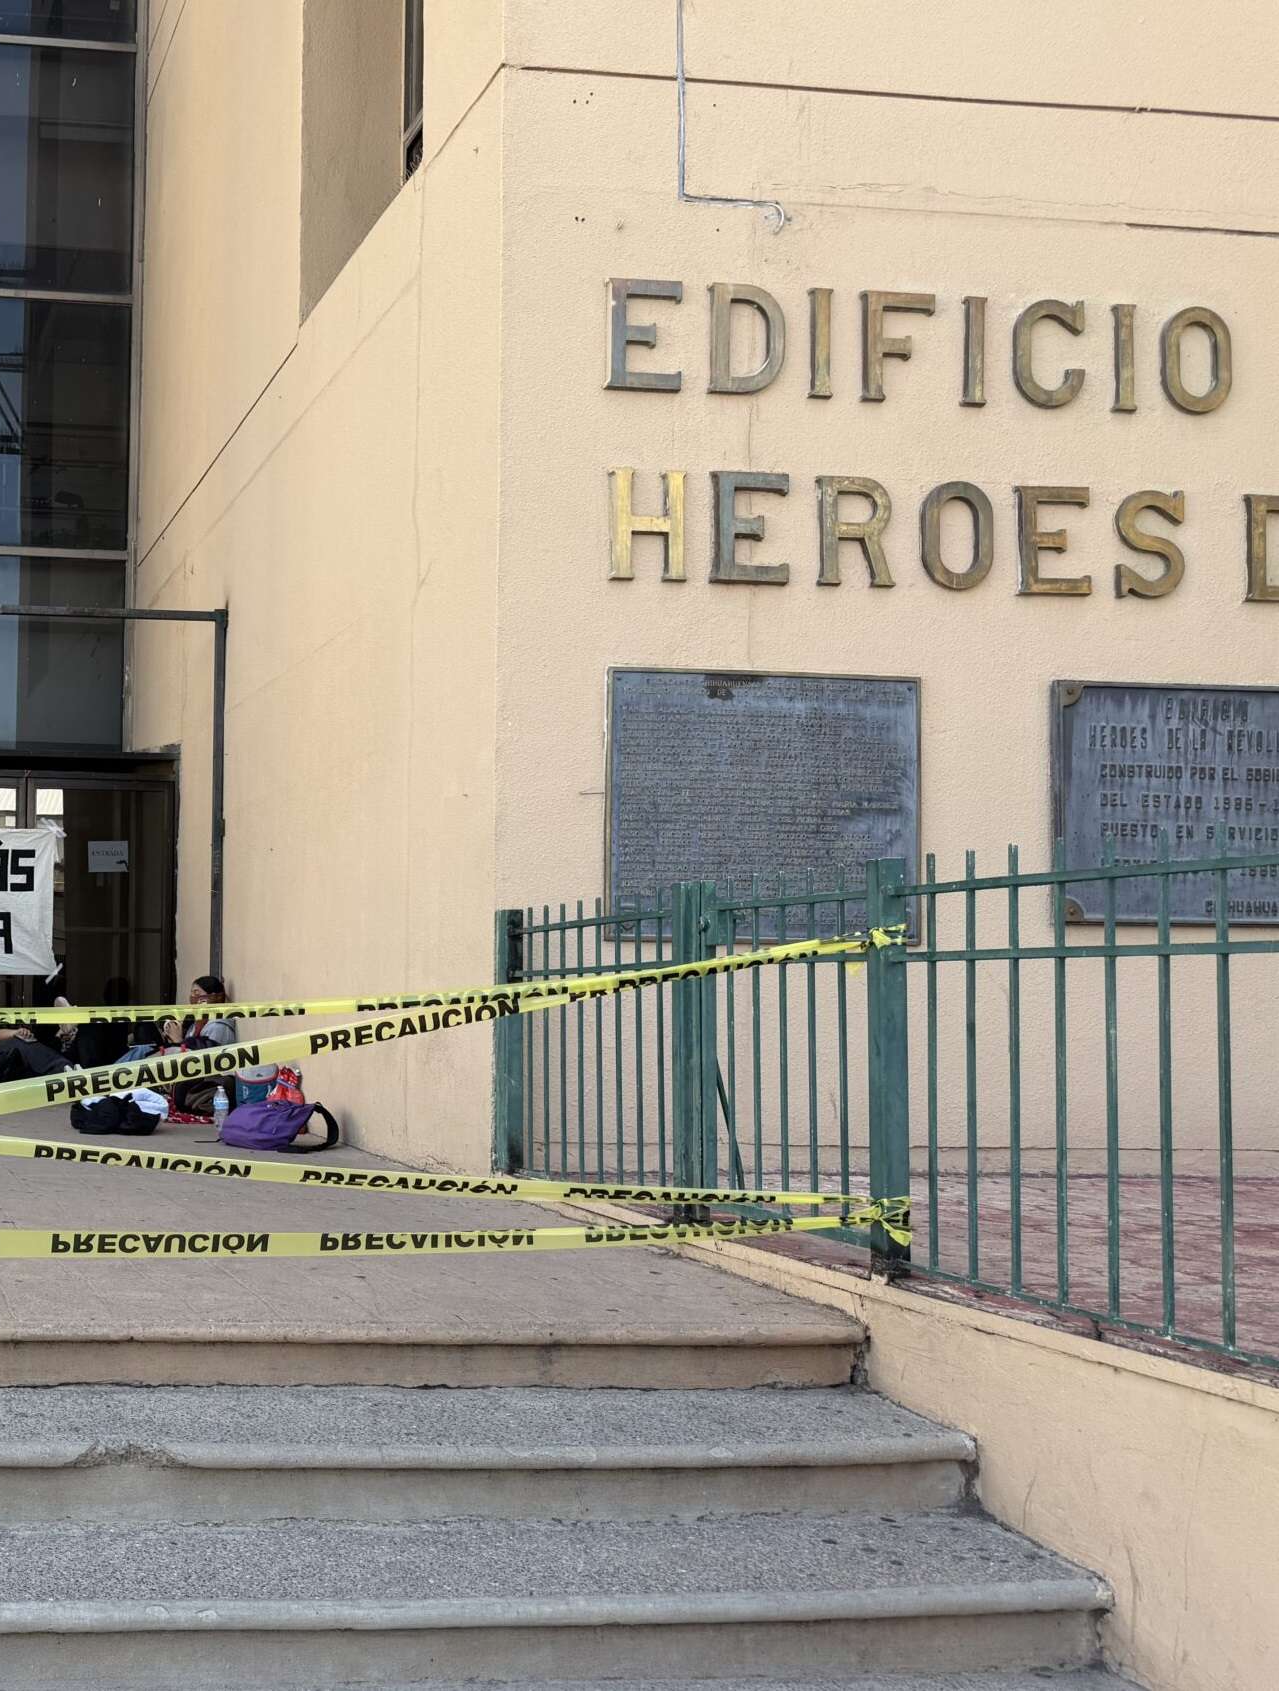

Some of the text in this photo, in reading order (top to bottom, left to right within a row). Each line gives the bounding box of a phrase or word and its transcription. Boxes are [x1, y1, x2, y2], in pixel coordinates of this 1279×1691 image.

[604, 277, 1233, 415] EDIFICIO
[608, 467, 1186, 600] HEROES
[1089, 724, 1148, 750] HEROES
[1166, 727, 1181, 750] DE
[1100, 764, 1184, 780] CONSTRUIDO
[1190, 765, 1216, 781] POR
[1222, 767, 1239, 781] EL
[1100, 792, 1127, 807] DEL
[1141, 793, 1203, 811] ESTADO
[1100, 822, 1279, 843] PUESTO EN SRVICIO
[44, 1045, 260, 1102] PRECAUCIÓN
[308, 997, 521, 1055] PRECAUCIÓN
[34, 1144, 252, 1178] PRECAUCIÓN
